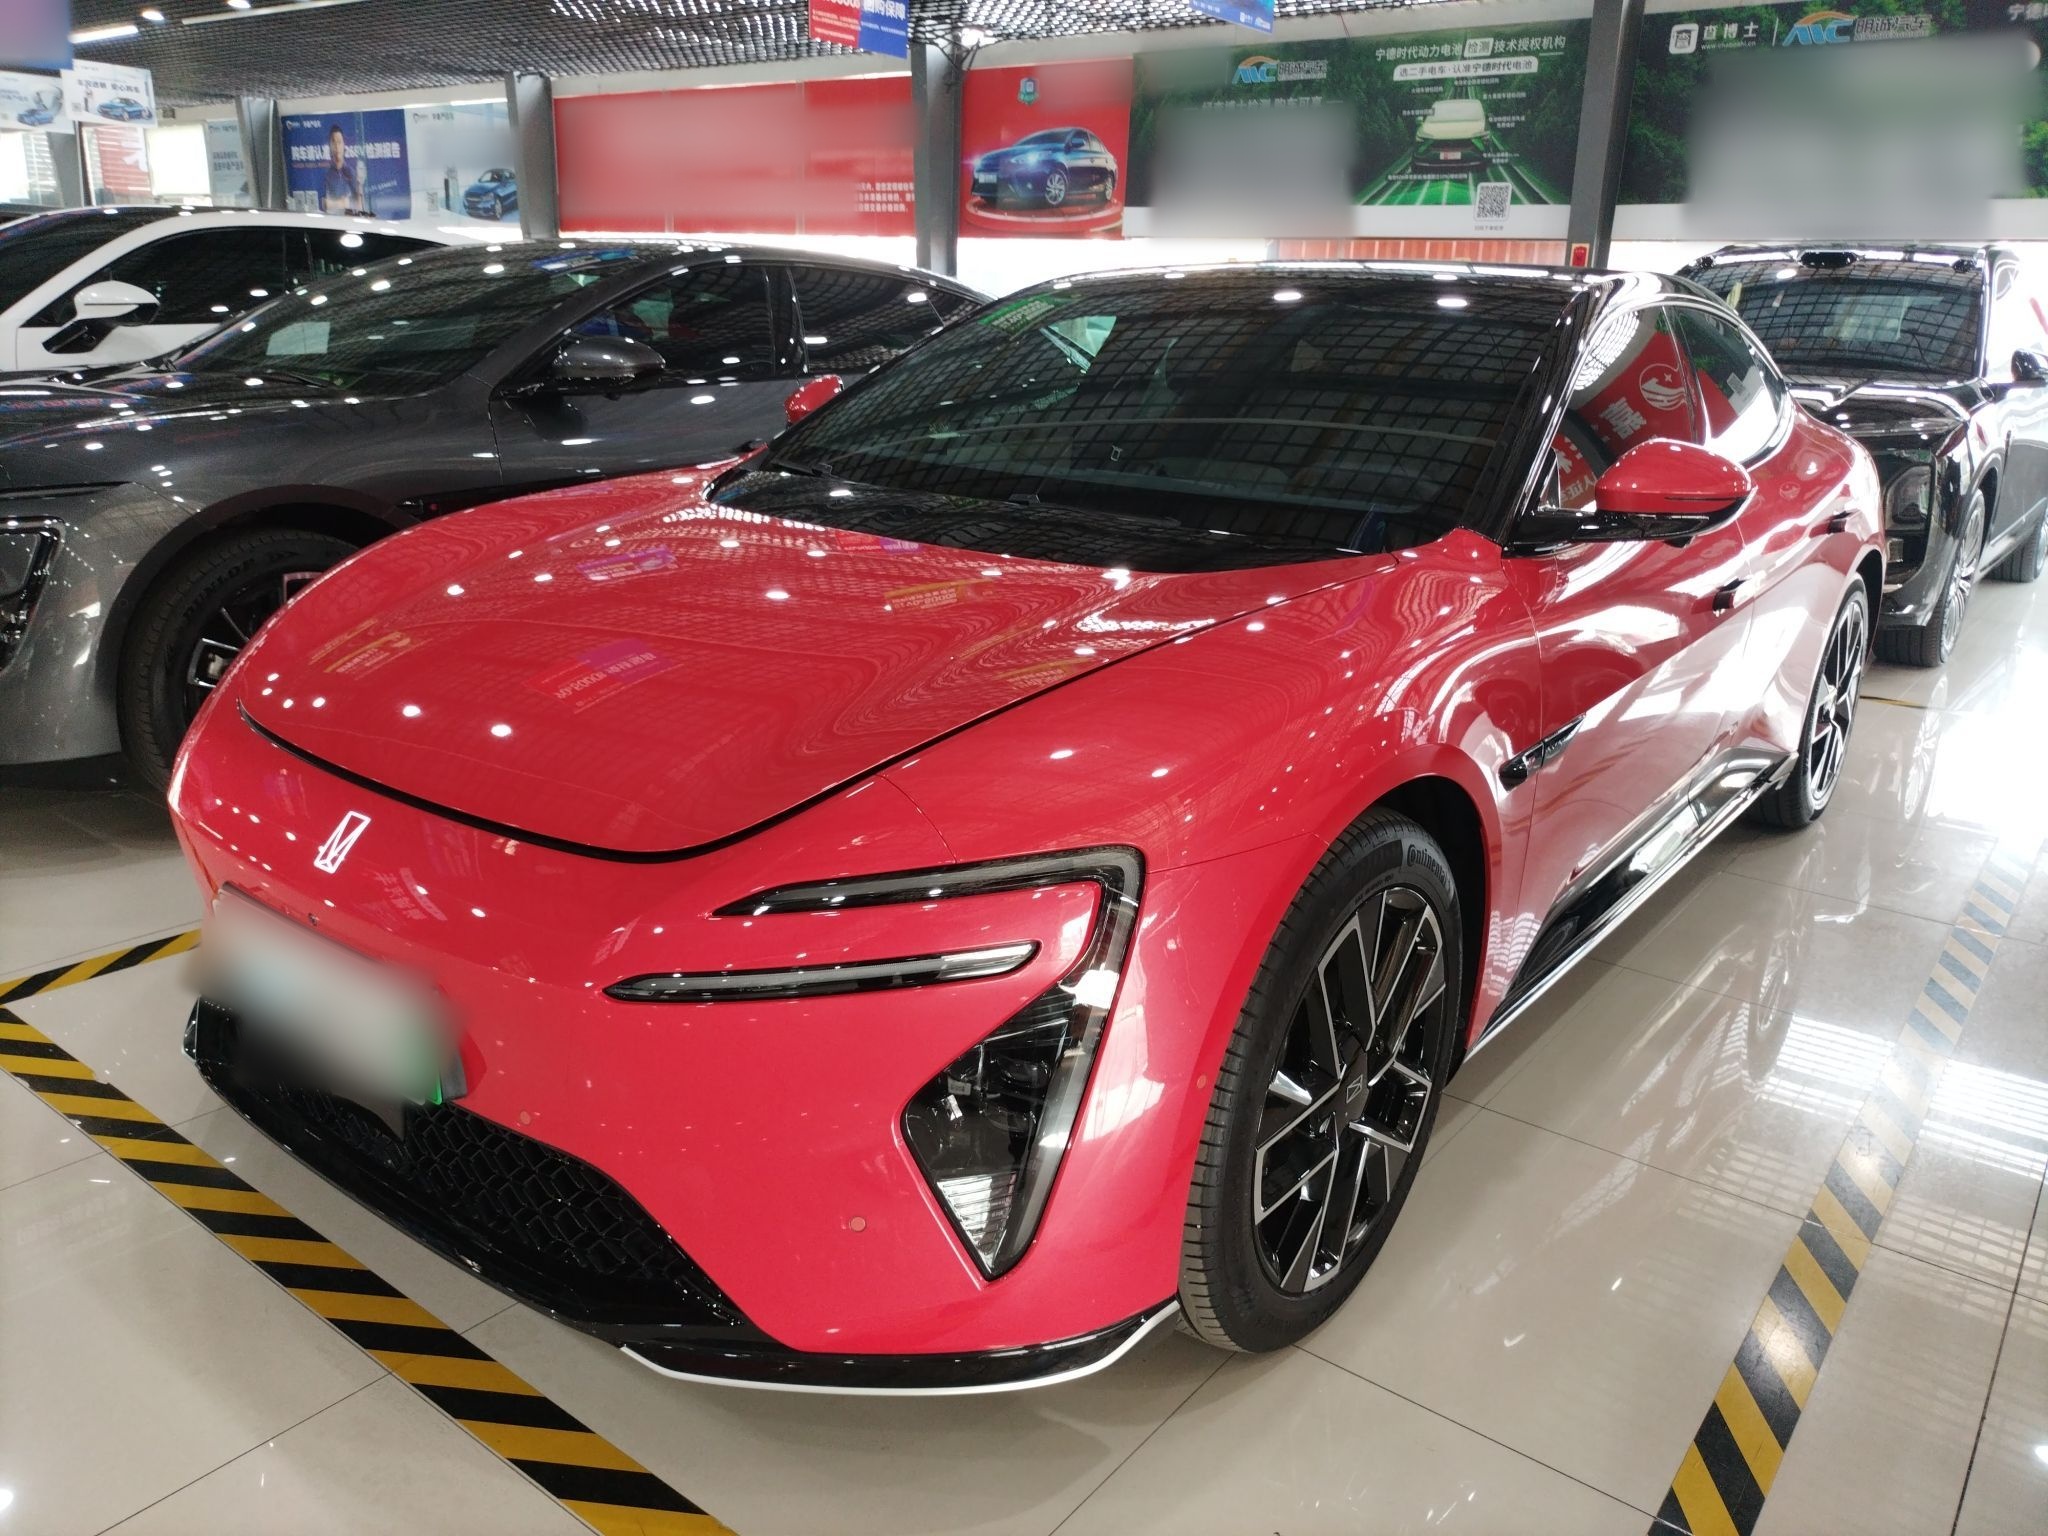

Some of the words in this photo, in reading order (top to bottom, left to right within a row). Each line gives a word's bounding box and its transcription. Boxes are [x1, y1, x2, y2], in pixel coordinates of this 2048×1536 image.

[2008, 4, 2048, 22] 宁德
[1702, 21, 1759, 40] 查博士
[1407, 844, 1448, 886] Continental
